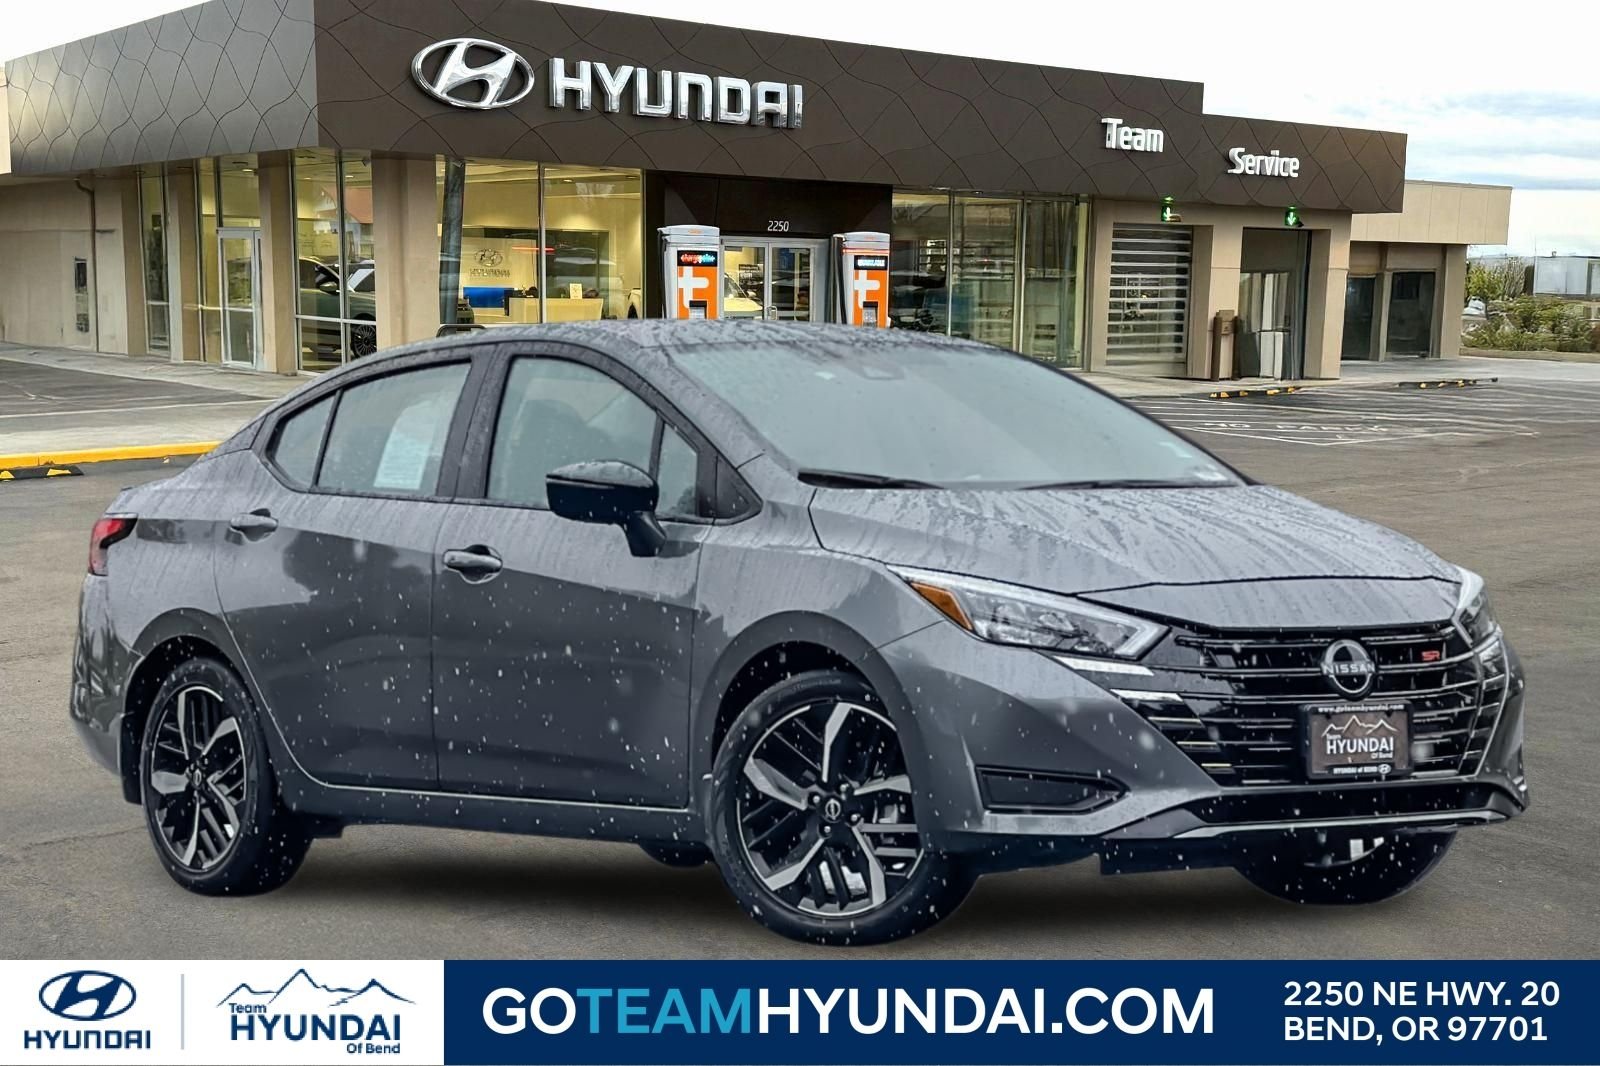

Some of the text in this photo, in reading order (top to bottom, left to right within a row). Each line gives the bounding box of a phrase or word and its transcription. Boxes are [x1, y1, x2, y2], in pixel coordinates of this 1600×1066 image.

[549, 57, 804, 128] HYUNDAI
[1100, 117, 1164, 153] Team
[1227, 147, 1300, 178] Service
[767, 220, 790, 232] 2250
[1421, 650, 1441, 661] SR
[1322, 662, 1376, 674] NISSAN
[1326, 736, 1394, 754] HYUNDAI
